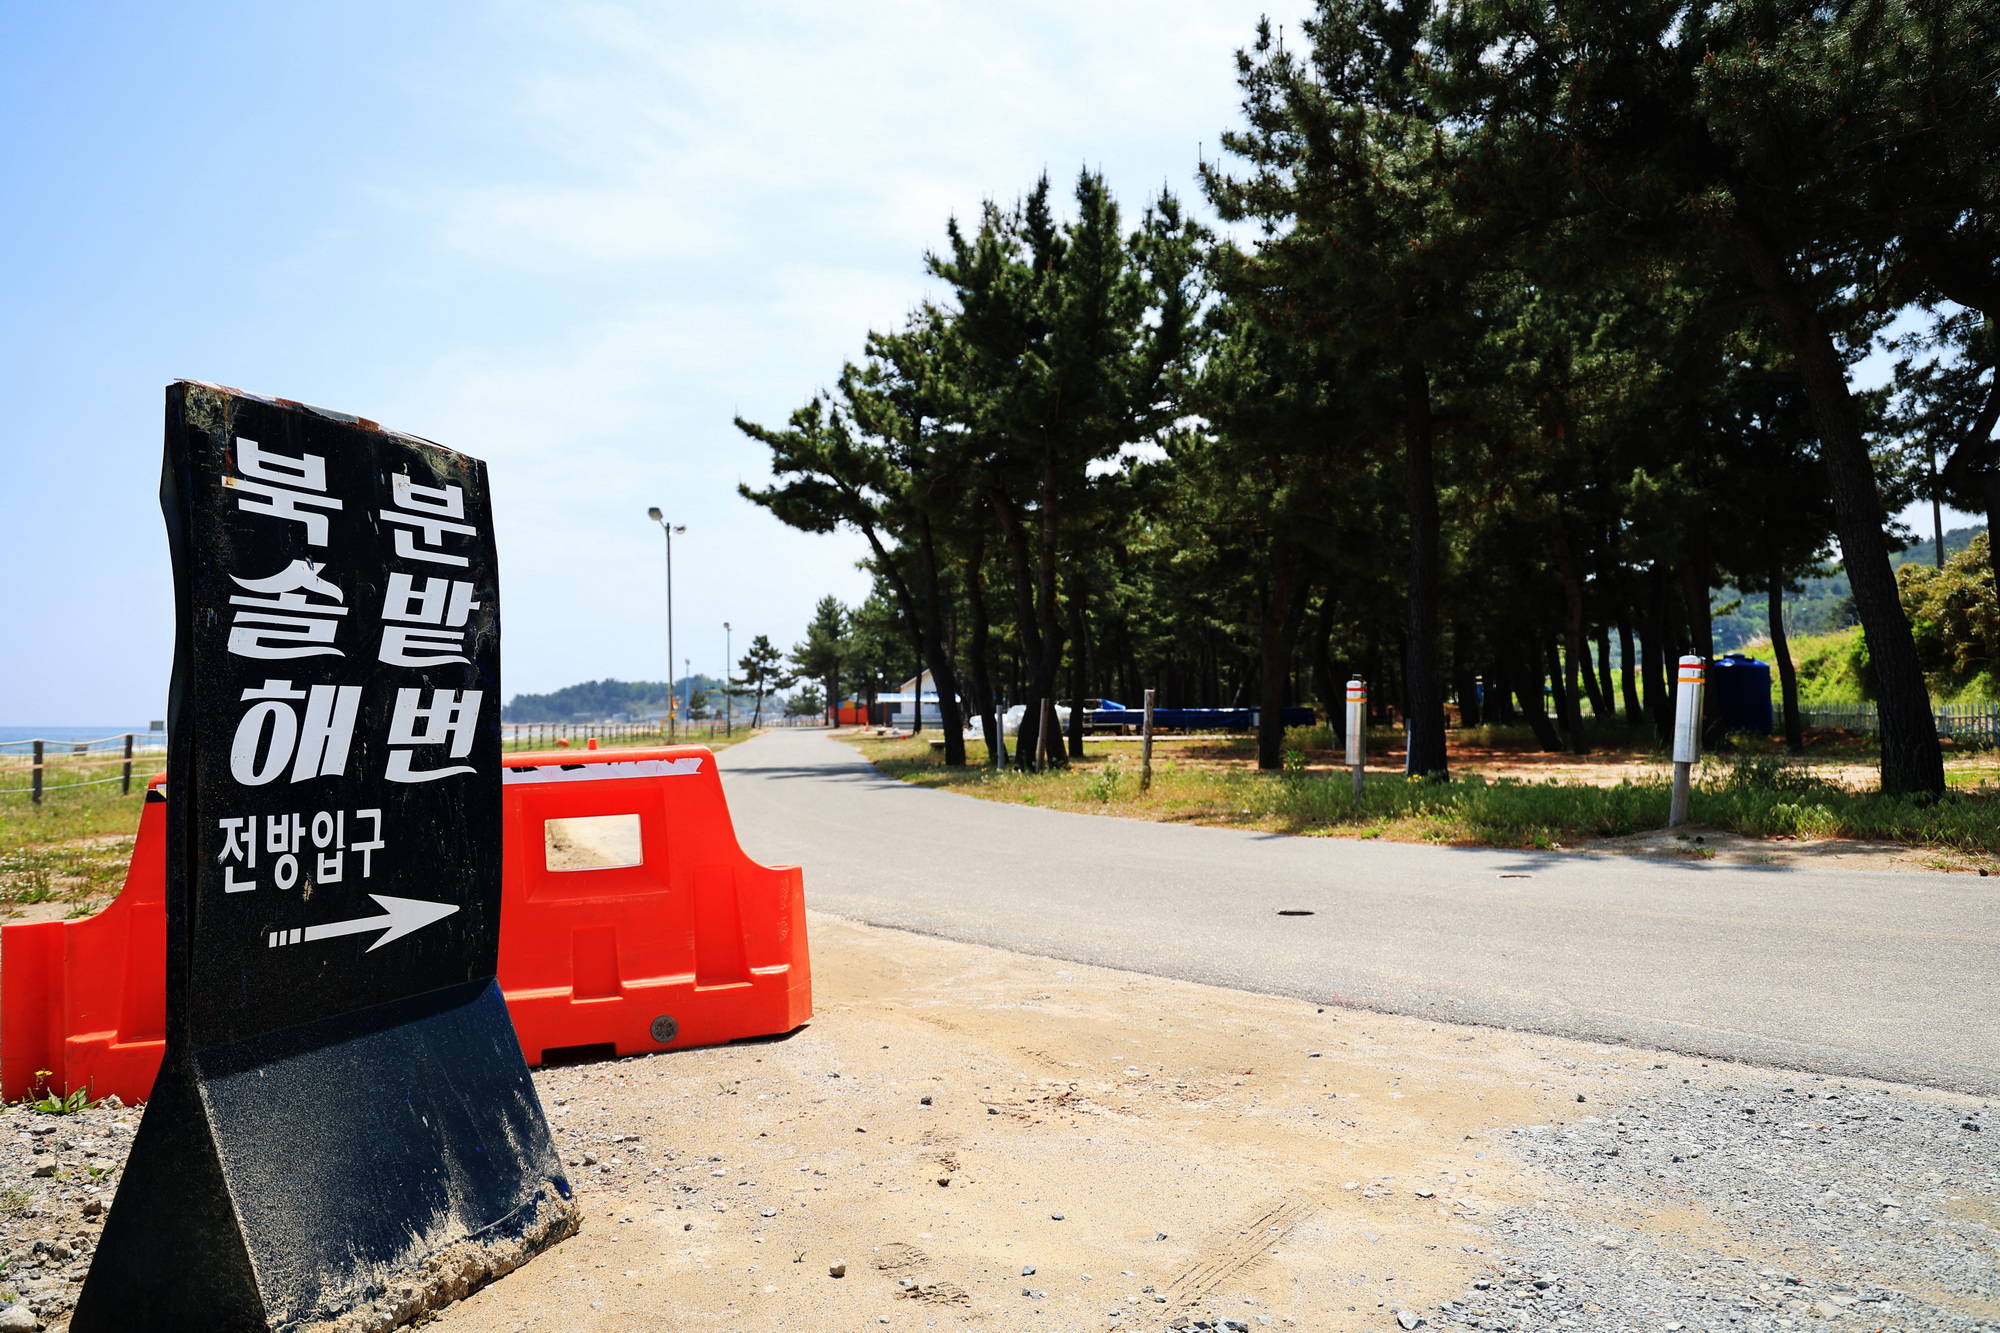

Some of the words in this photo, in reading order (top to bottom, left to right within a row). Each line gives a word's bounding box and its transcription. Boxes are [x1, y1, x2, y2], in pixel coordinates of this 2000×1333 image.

[222, 437, 477, 568] 북분
[228, 559, 480, 668] 솔밭
[230, 679, 484, 786] 해변
[217, 808, 385, 894] 전방입구
